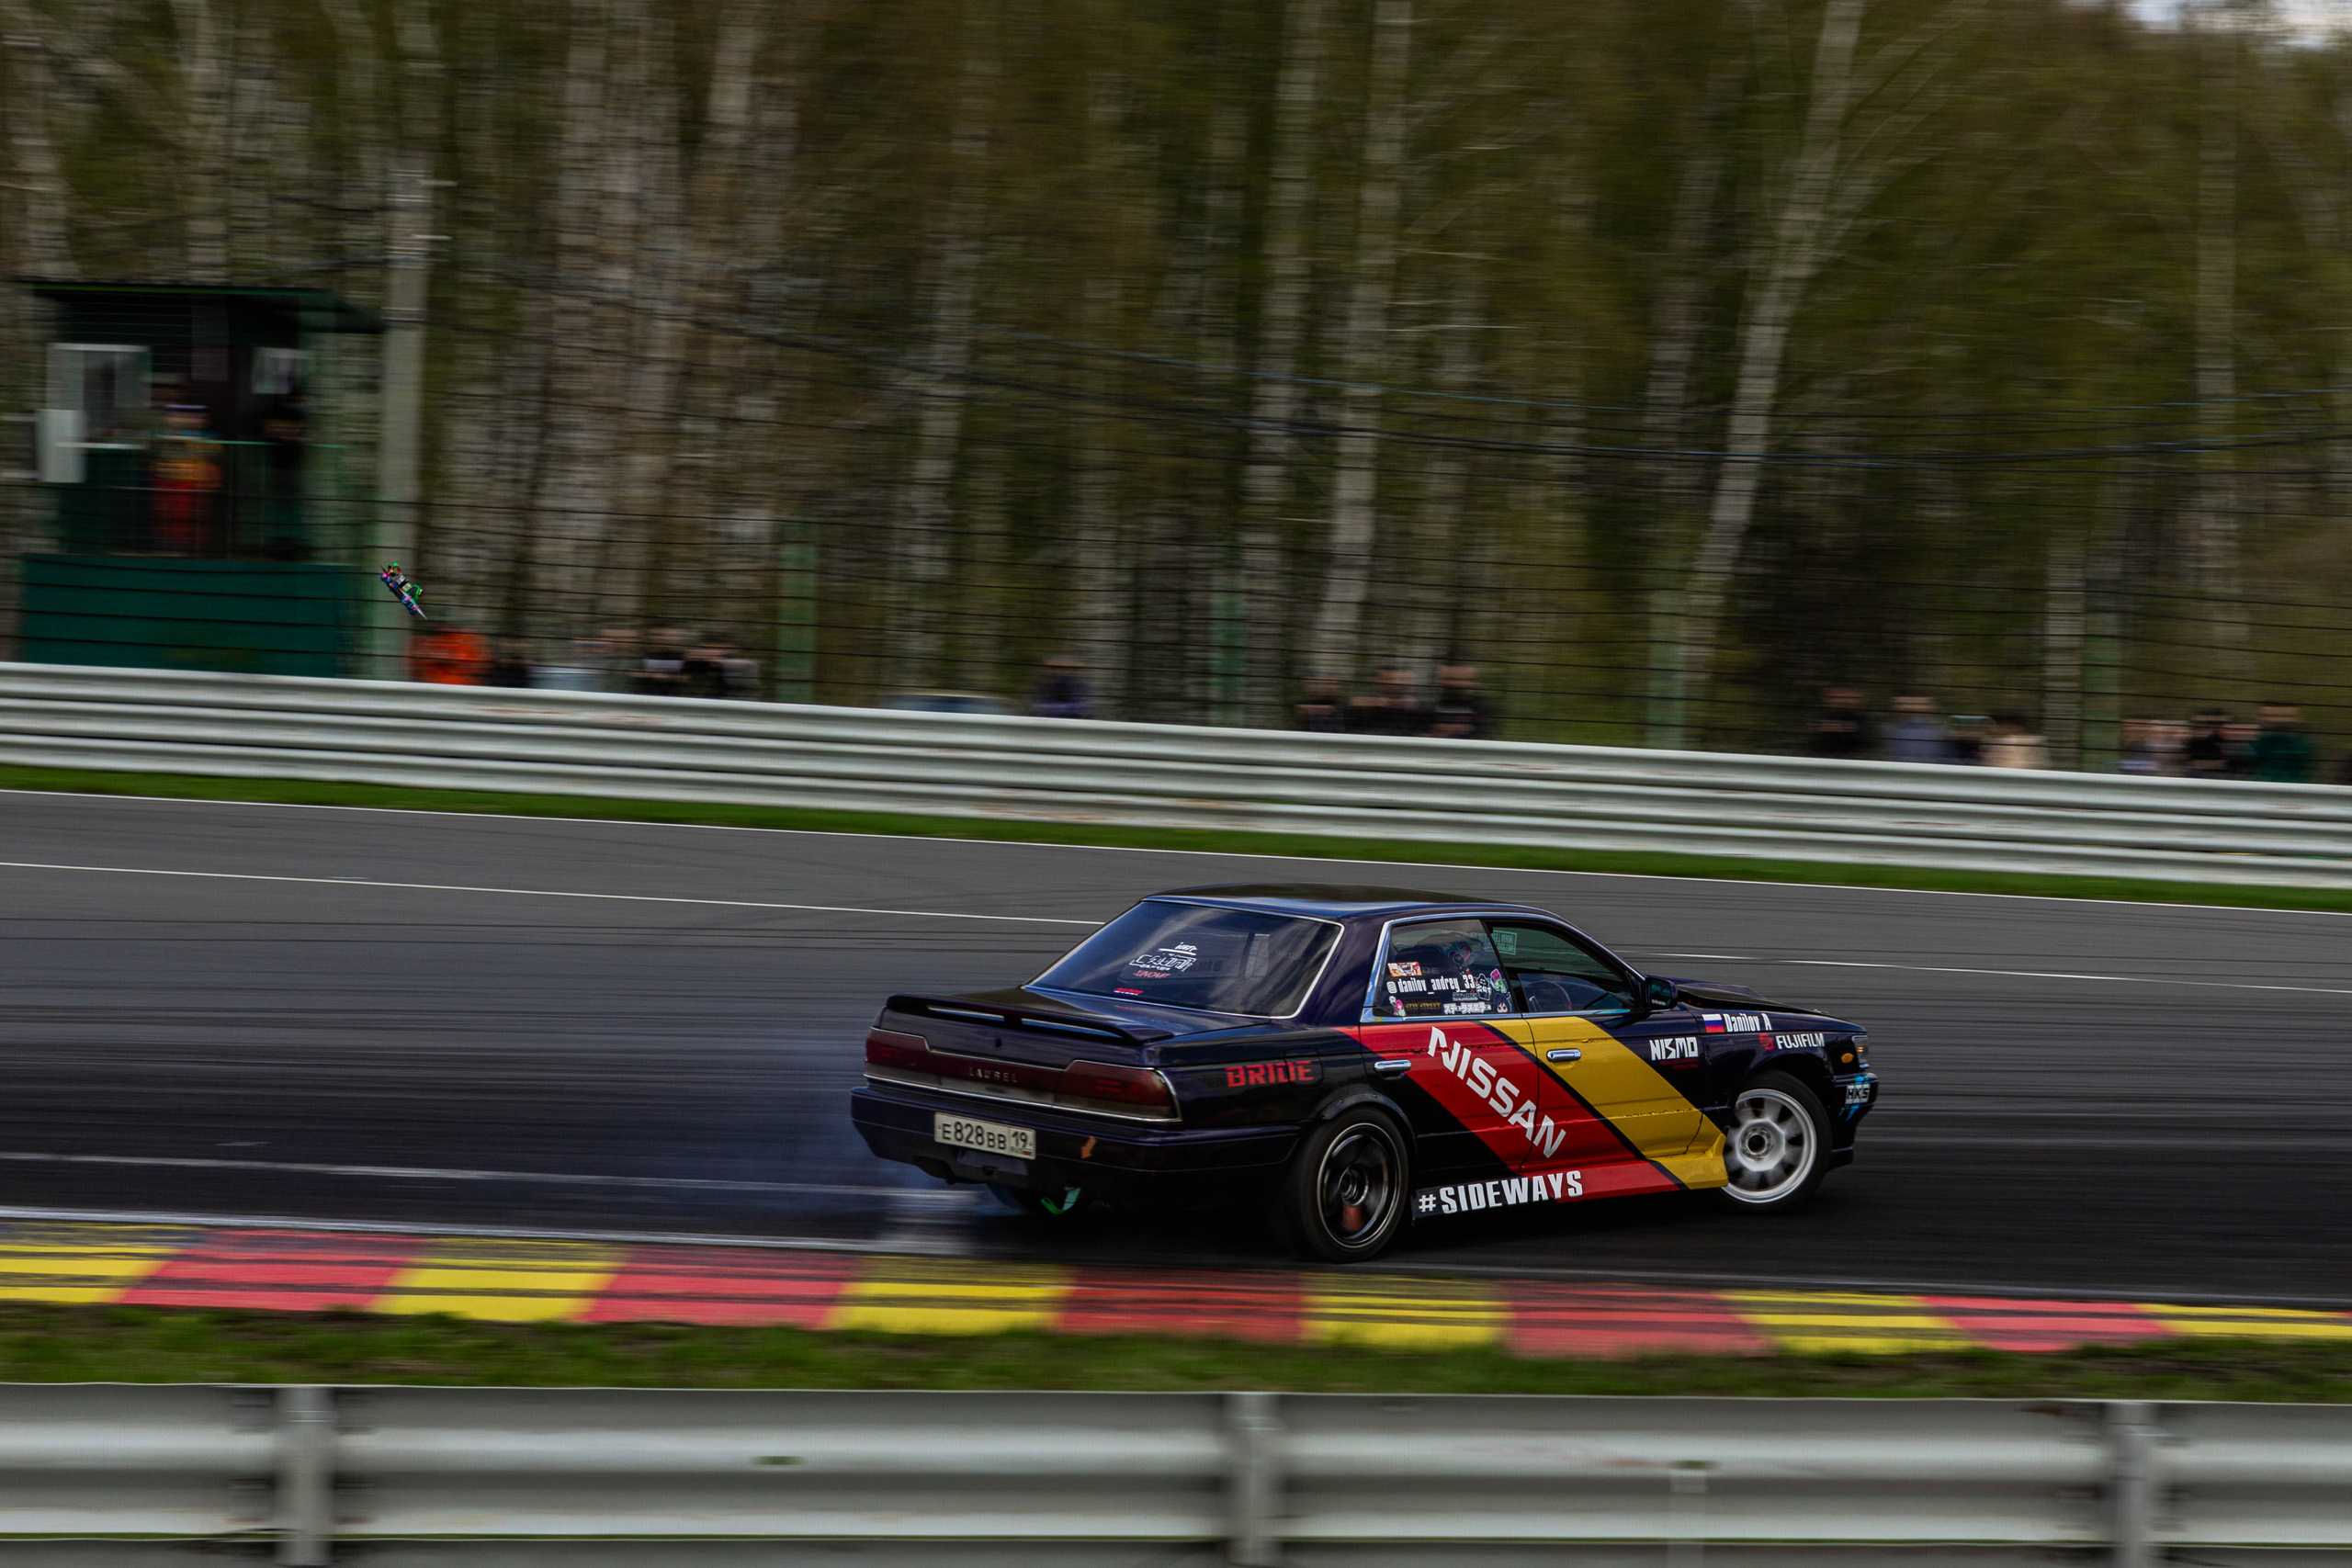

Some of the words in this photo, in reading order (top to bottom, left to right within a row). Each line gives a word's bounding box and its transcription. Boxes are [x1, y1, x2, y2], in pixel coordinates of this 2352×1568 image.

[1723, 1014, 1760, 1032] Danilov
[1761, 1013, 1772, 1031] A
[1649, 1036, 1699, 1061] NISMO
[1775, 1033, 1825, 1050] FUJIFILM
[1225, 1061, 1314, 1087] BRIDE
[1427, 1026, 1566, 1158] NISSAN
[1012, 1131, 1028, 1148] 19
[1419, 1170, 1583, 1214] #SIDEWAYS
